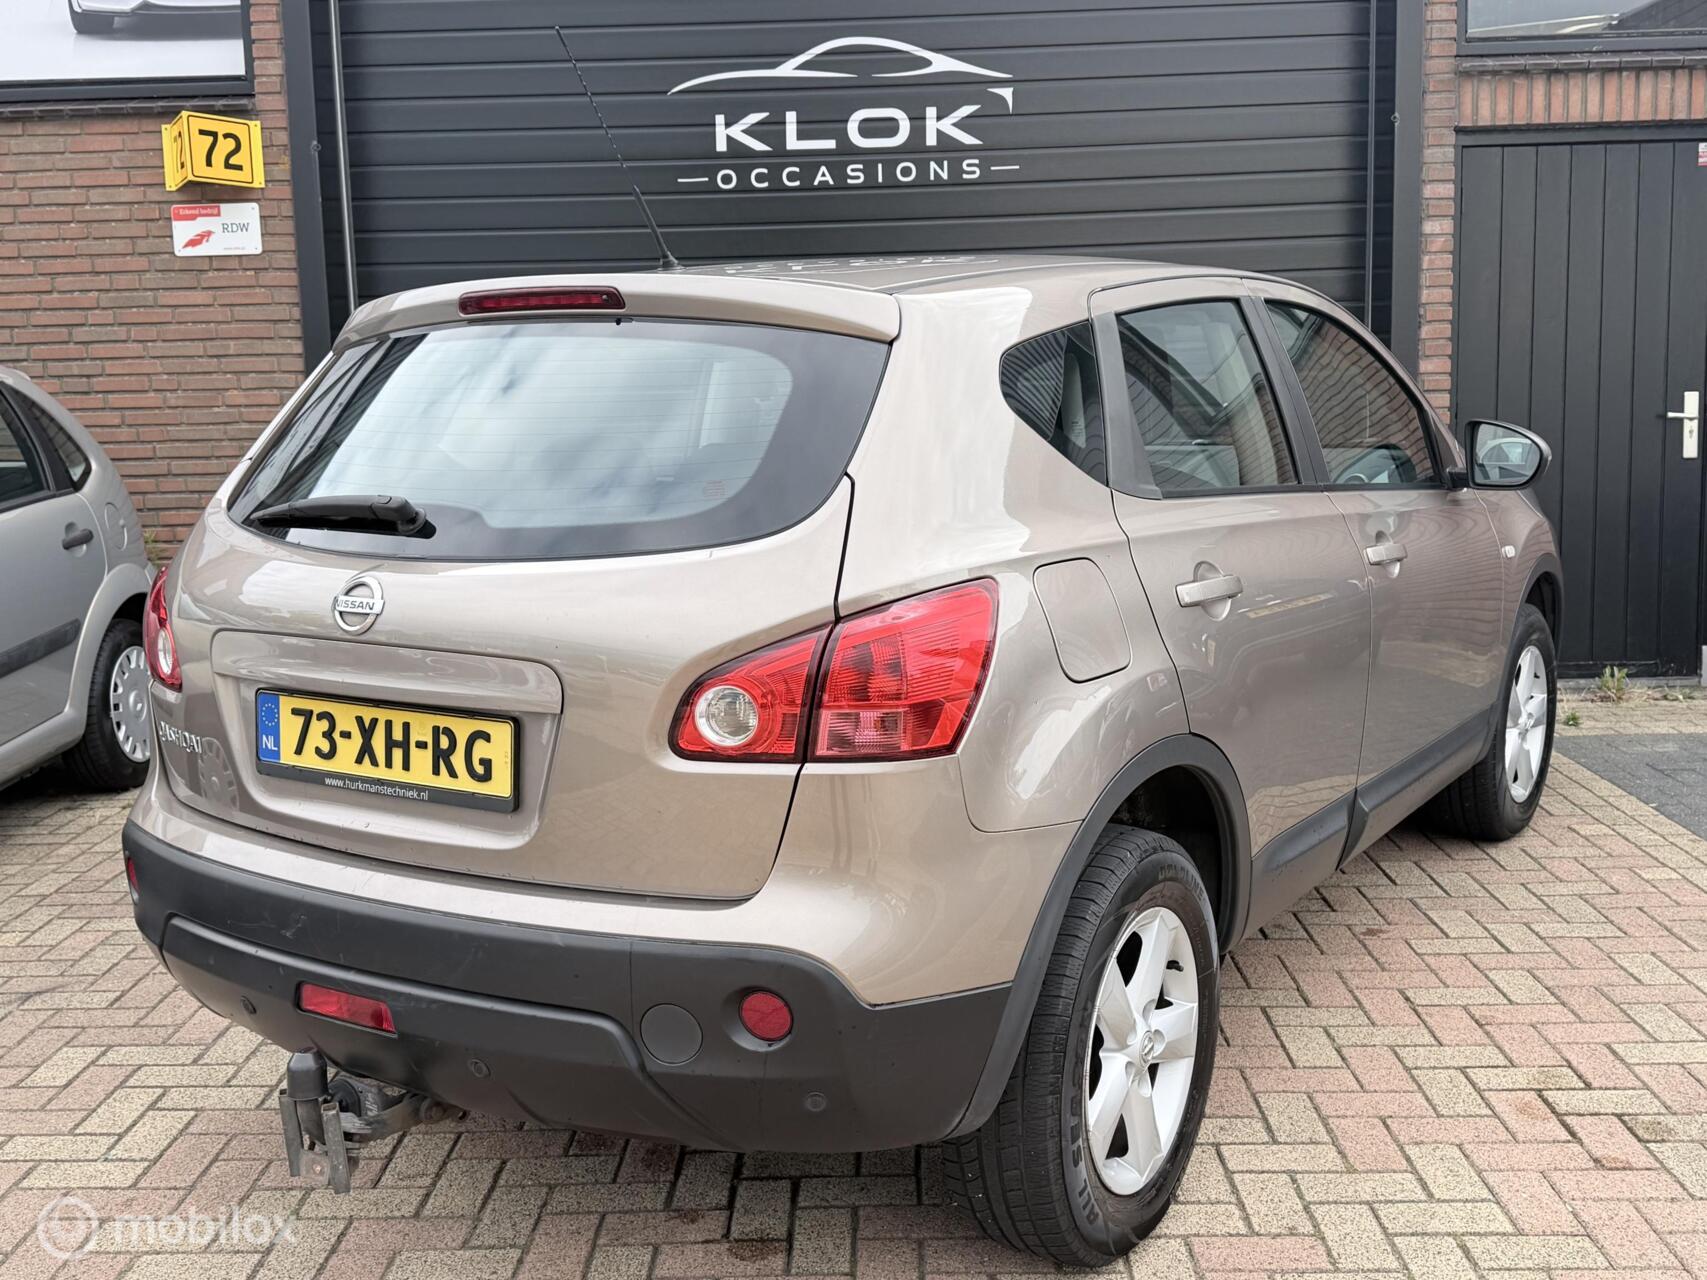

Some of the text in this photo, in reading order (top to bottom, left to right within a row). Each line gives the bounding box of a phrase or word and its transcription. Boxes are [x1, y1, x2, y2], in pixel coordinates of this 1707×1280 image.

[715, 105, 983, 152] KLOK
[198, 128, 244, 172] 72
[716, 159, 981, 190] OCCASIONS
[221, 222, 250, 233] RDW
[336, 598, 375, 611] NISSAN
[262, 734, 278, 751] NL
[291, 707, 493, 783] 73-XH-RG
[325, 777, 428, 801] www.hurkmanstechniek.nl
[1078, 1179, 1099, 1226] ALL
